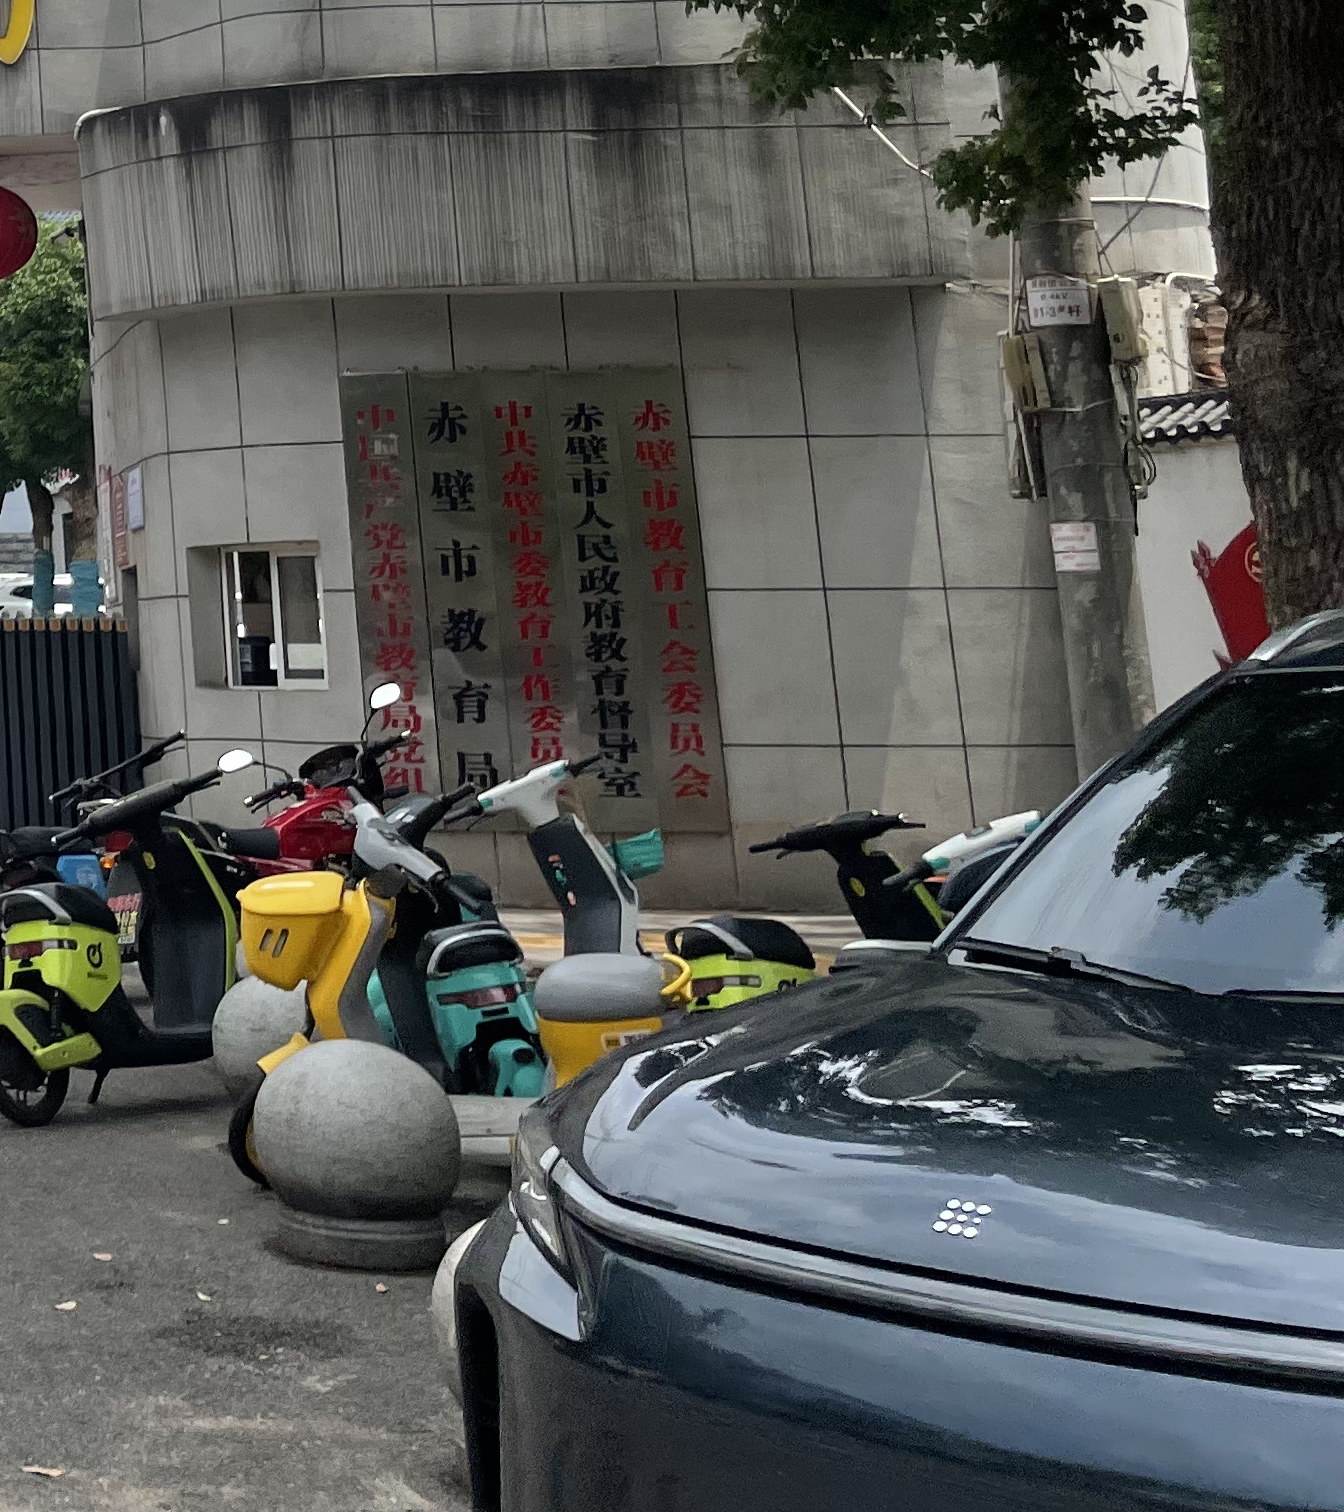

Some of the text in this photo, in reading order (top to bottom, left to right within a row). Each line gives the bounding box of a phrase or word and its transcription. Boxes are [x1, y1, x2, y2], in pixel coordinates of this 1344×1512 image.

[427, 400, 499, 790] 赤壁市教育局
[494, 399, 570, 796] 中共赤壁市委教育工作委员
[561, 402, 643, 799] 赤壁市人民政府教育督导室
[631, 399, 715, 800] 赤壁市教育工会委员会
